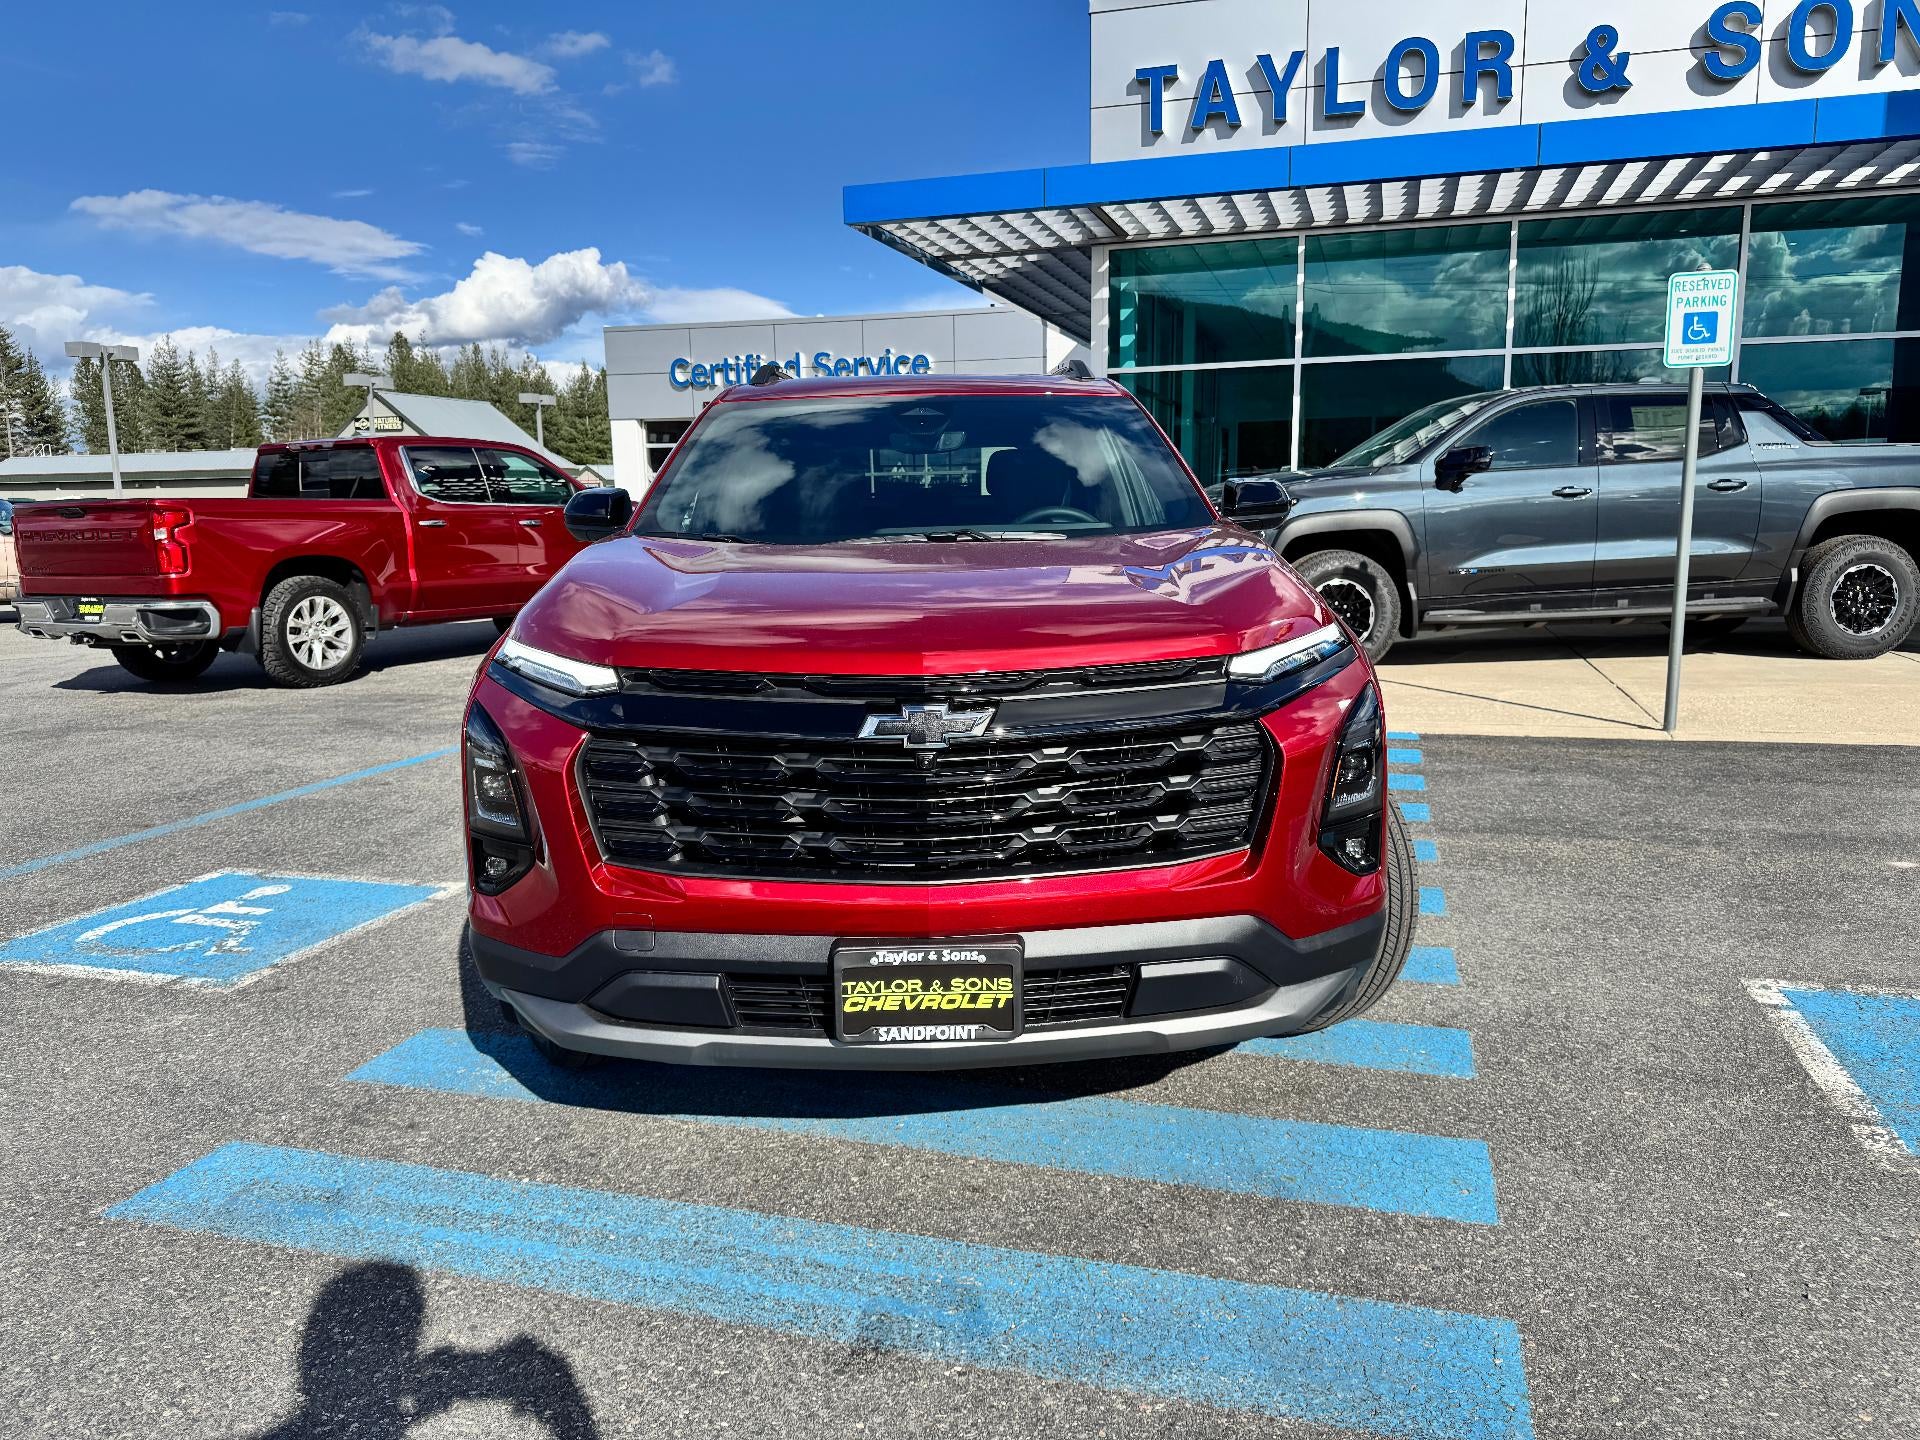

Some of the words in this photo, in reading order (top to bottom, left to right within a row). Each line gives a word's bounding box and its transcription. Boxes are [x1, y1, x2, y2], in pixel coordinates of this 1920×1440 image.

[1135, 29, 1515, 134] TAYLOR
[1577, 24, 1632, 93] &
[1674, 278, 1732, 292] RESERVED
[1676, 295, 1727, 308] PARKING
[670, 352, 801, 387] Certifid
[813, 349, 930, 377] Service
[20, 529, 139, 543] CHEVROLET
[876, 951, 924, 965] Taylor
[928, 952, 938, 961] &
[942, 950, 979, 962] Sons
[842, 980, 922, 994] TAYLOR
[929, 980, 943, 993] &
[950, 978, 1013, 992] SONS
[843, 994, 1013, 1012] CHEVROLET
[878, 1025, 979, 1042] SANDPOINT
